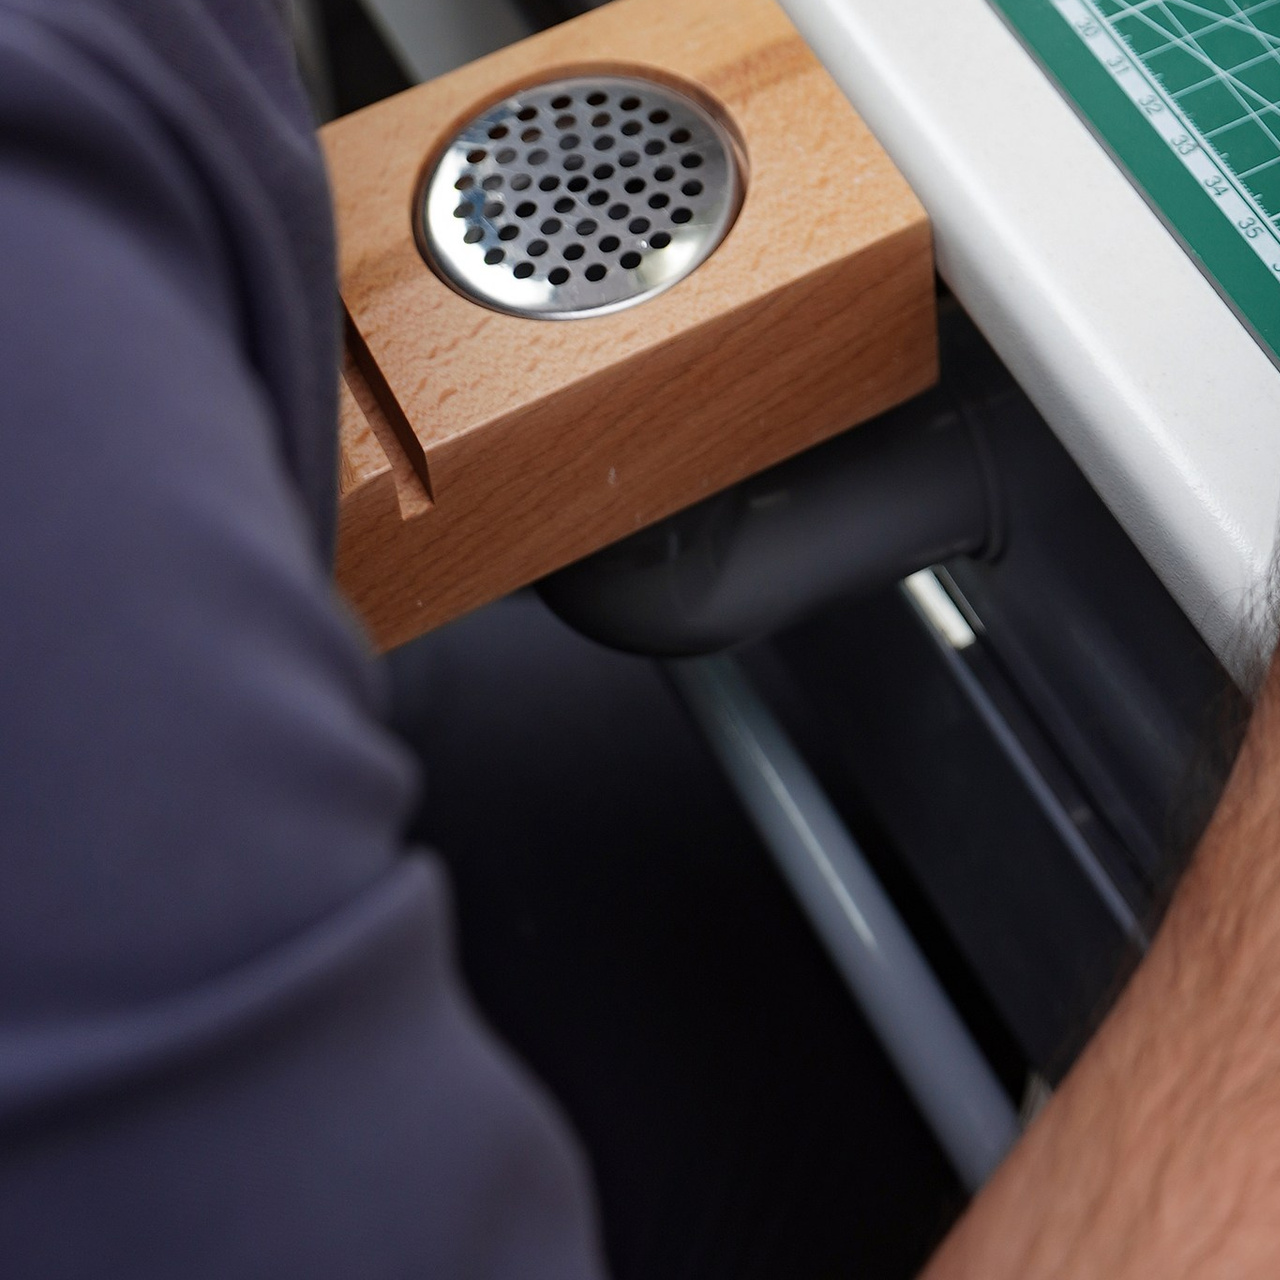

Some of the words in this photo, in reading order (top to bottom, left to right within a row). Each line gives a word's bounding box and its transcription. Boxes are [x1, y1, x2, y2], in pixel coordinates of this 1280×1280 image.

[1077, 17, 1099, 37] 30
[1107, 55, 1130, 75] 31
[1139, 94, 1163, 115] 32
[1171, 134, 1197, 155] 33
[1205, 175, 1229, 196] 34
[1237, 217, 1265, 239] 35
